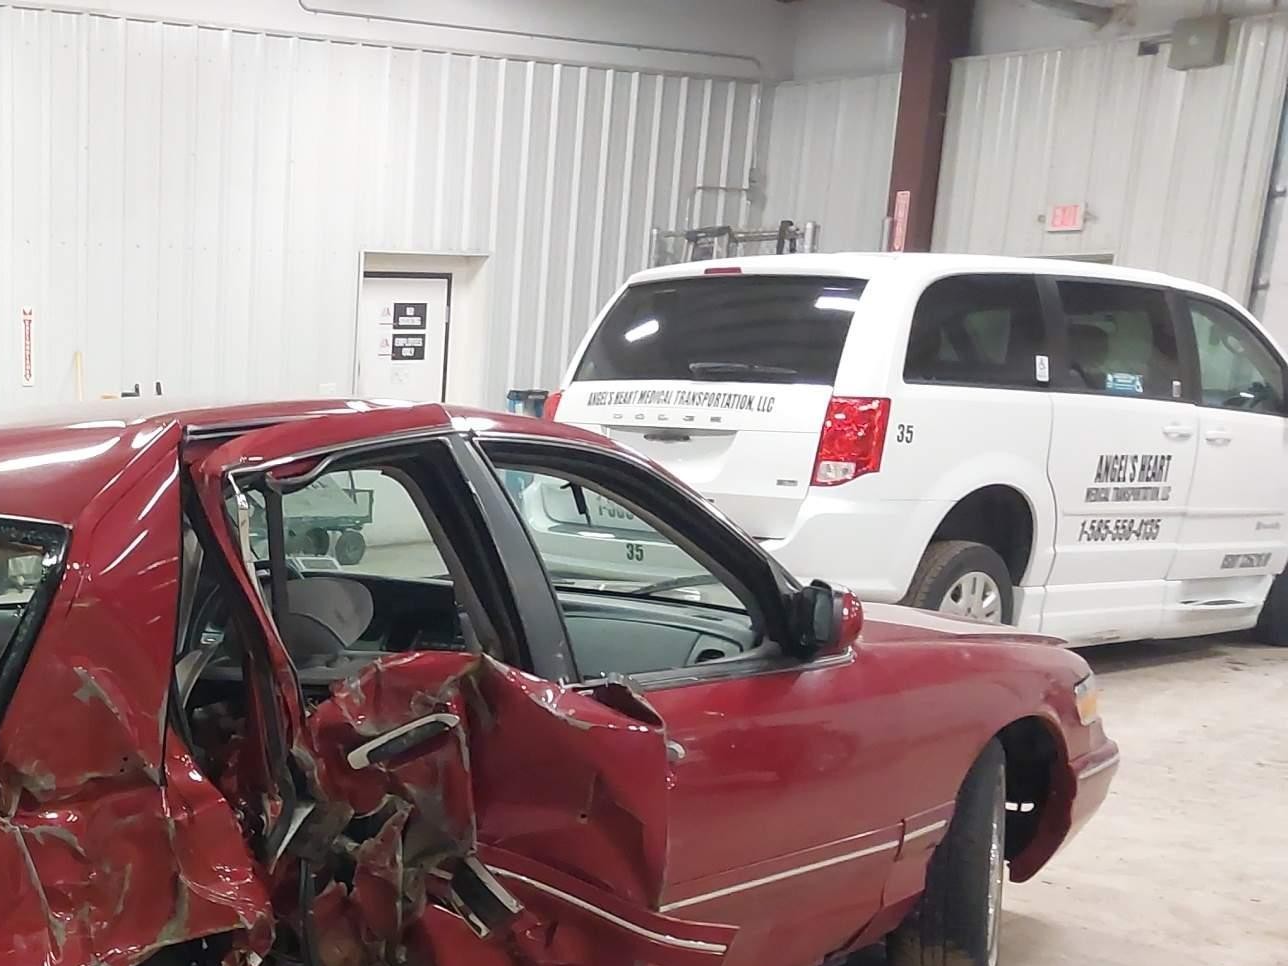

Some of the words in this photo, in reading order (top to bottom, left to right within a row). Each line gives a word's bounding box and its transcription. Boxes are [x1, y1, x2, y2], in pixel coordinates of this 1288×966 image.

[757, 395, 776, 412] LLC
[896, 423, 914, 444] 35
[1137, 454, 1172, 482] HEART
[626, 543, 645, 562] 35
